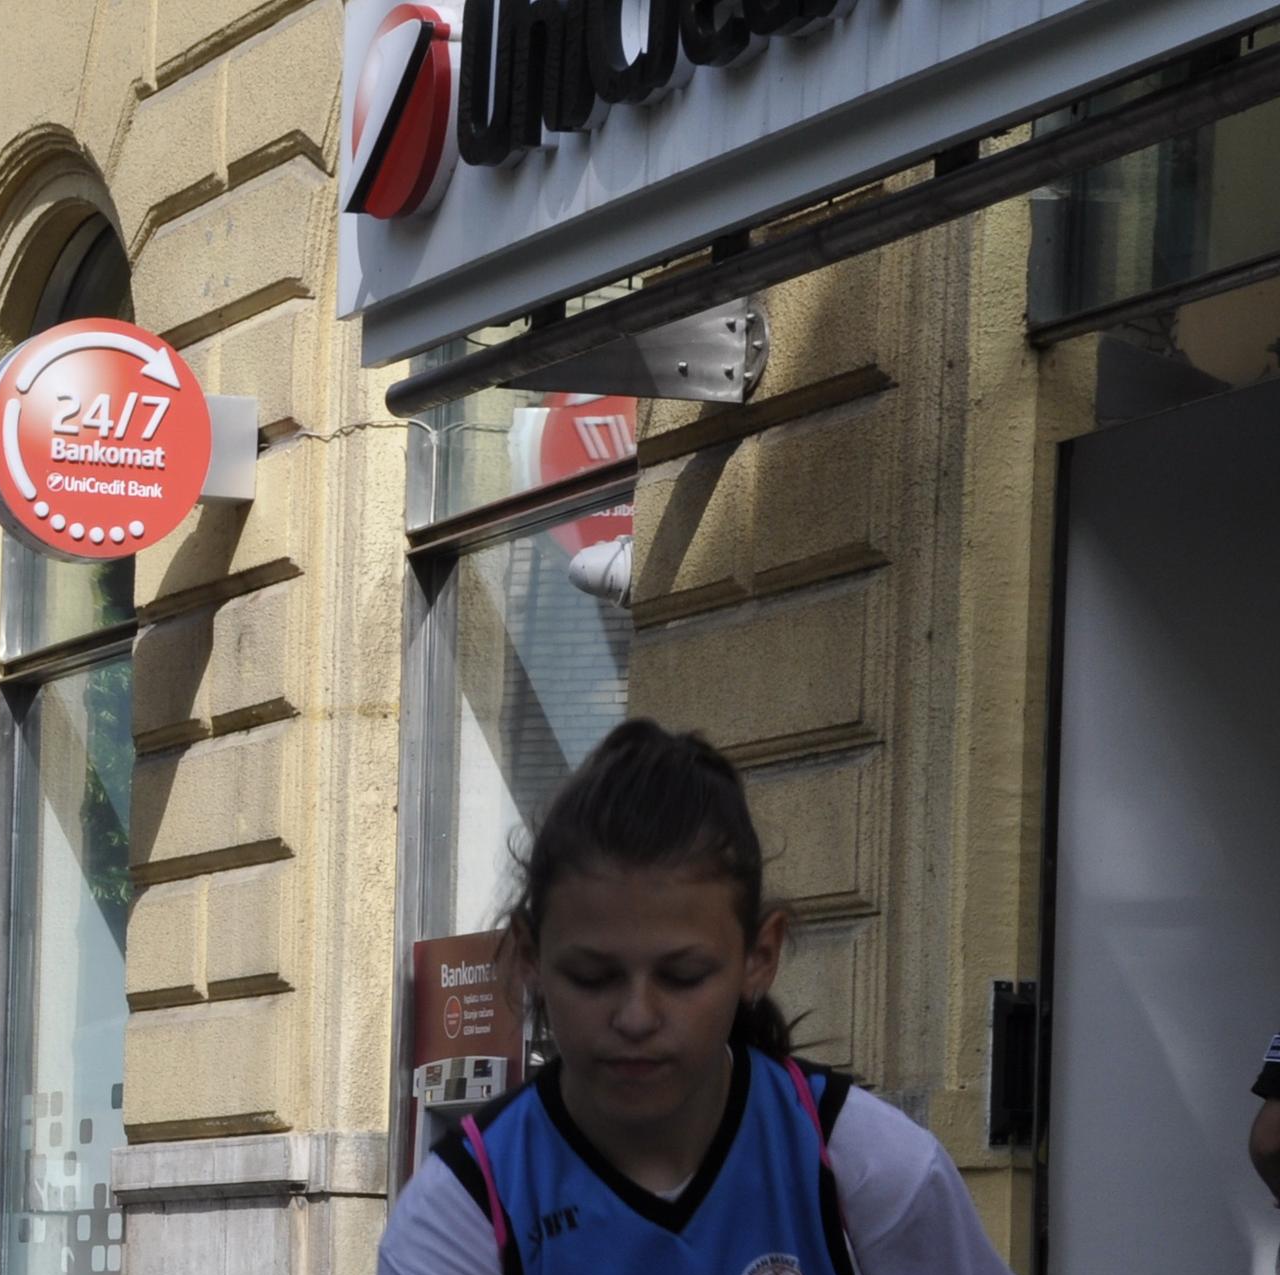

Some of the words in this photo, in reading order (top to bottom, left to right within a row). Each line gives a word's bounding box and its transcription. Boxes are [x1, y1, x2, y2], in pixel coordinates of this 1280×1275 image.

[51, 391, 171, 441] 24/7
[51, 437, 165, 471] Bankomat
[64, 475, 126, 496] UniCredit
[127, 480, 163, 498] Bank
